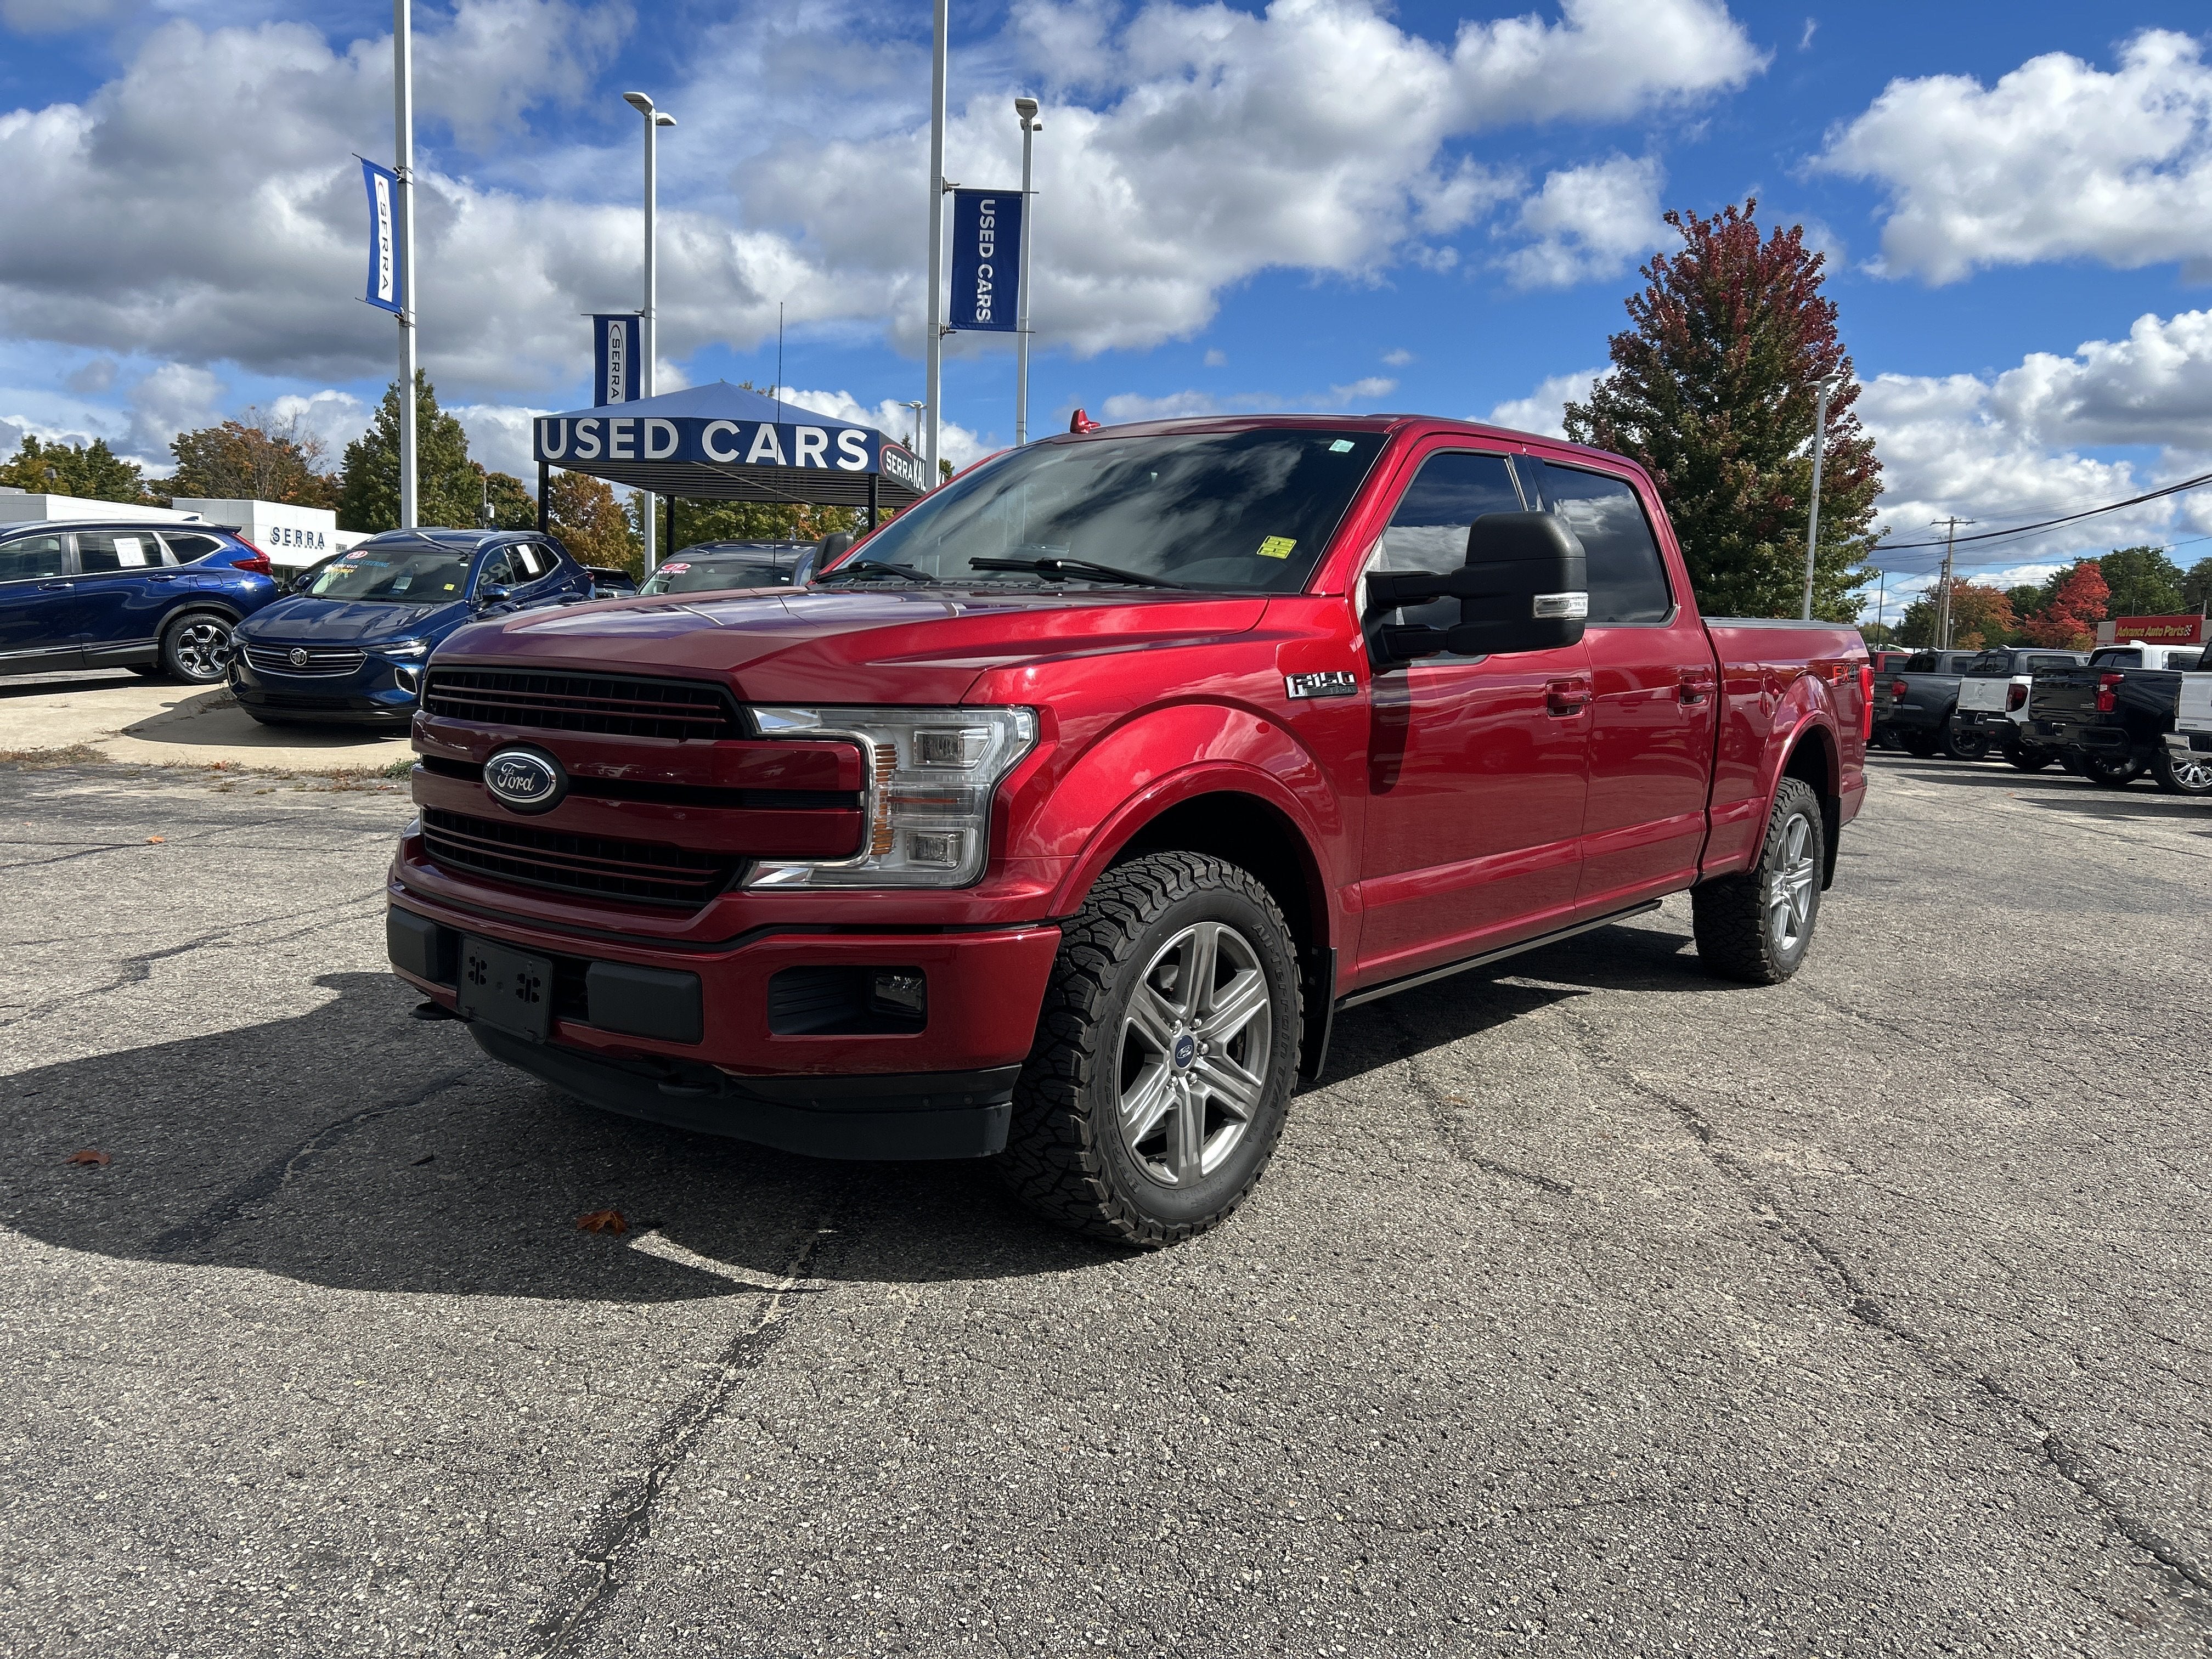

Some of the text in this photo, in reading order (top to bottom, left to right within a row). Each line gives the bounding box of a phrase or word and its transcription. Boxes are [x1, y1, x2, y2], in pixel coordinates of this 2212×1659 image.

[380, 201, 389, 290] SERRA
[975, 199, 995, 321] USED CARS
[611, 338, 620, 399] SERRA
[540, 417, 868, 471] USED CARS
[272, 526, 325, 548] SERRA
[2115, 624, 2185, 637] Advance Auto Parts
[1833, 664, 1858, 686] FX4
[497, 761, 536, 792] Ford
